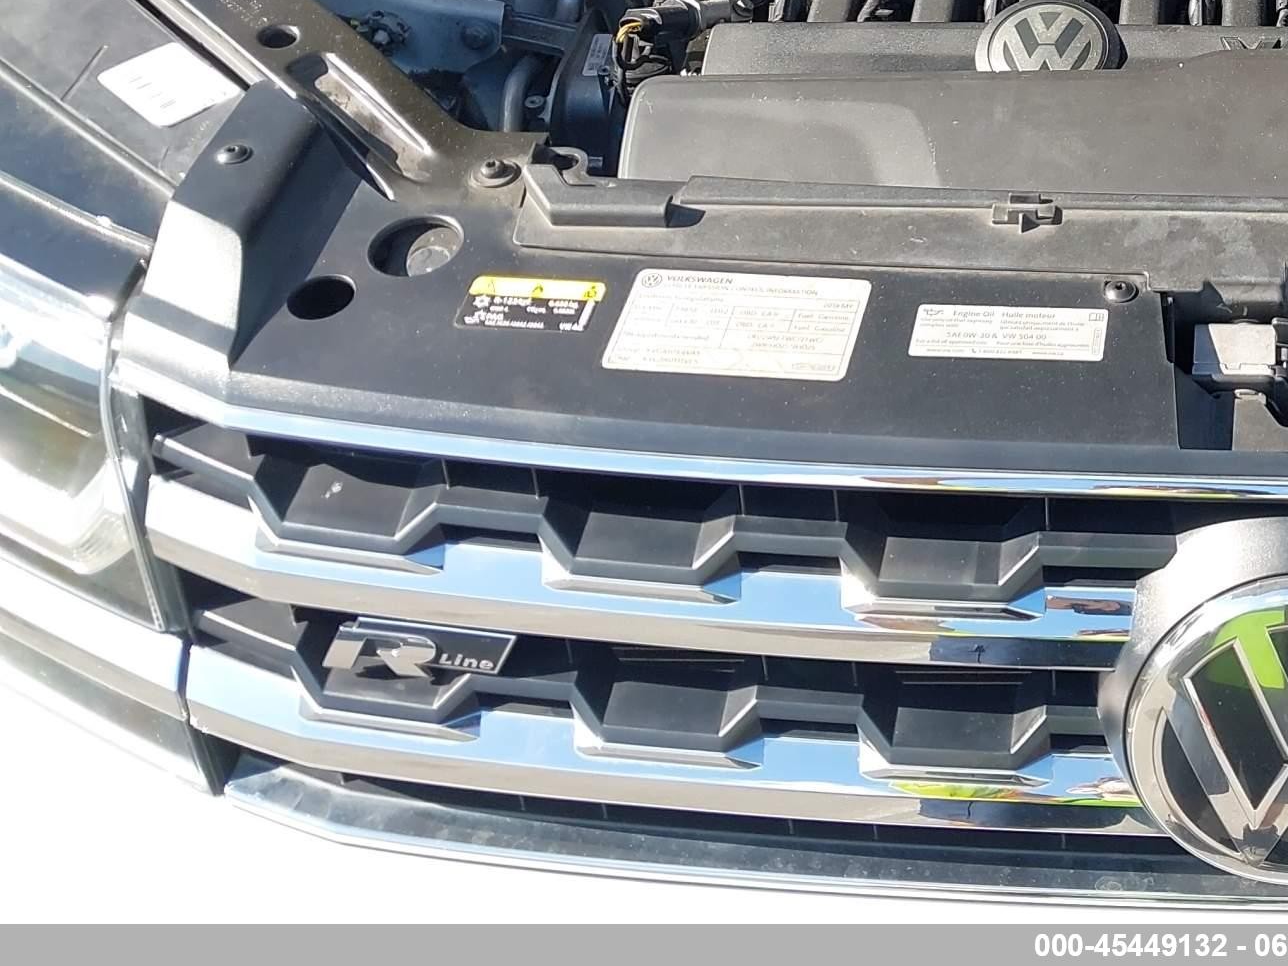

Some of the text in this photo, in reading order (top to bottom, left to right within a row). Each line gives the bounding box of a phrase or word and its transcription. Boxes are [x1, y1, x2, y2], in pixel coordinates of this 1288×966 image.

[666, 275, 733, 285] VOLKSWAGEN
[953, 310, 980, 319] Engine
[440, 654, 495, 671] Line
